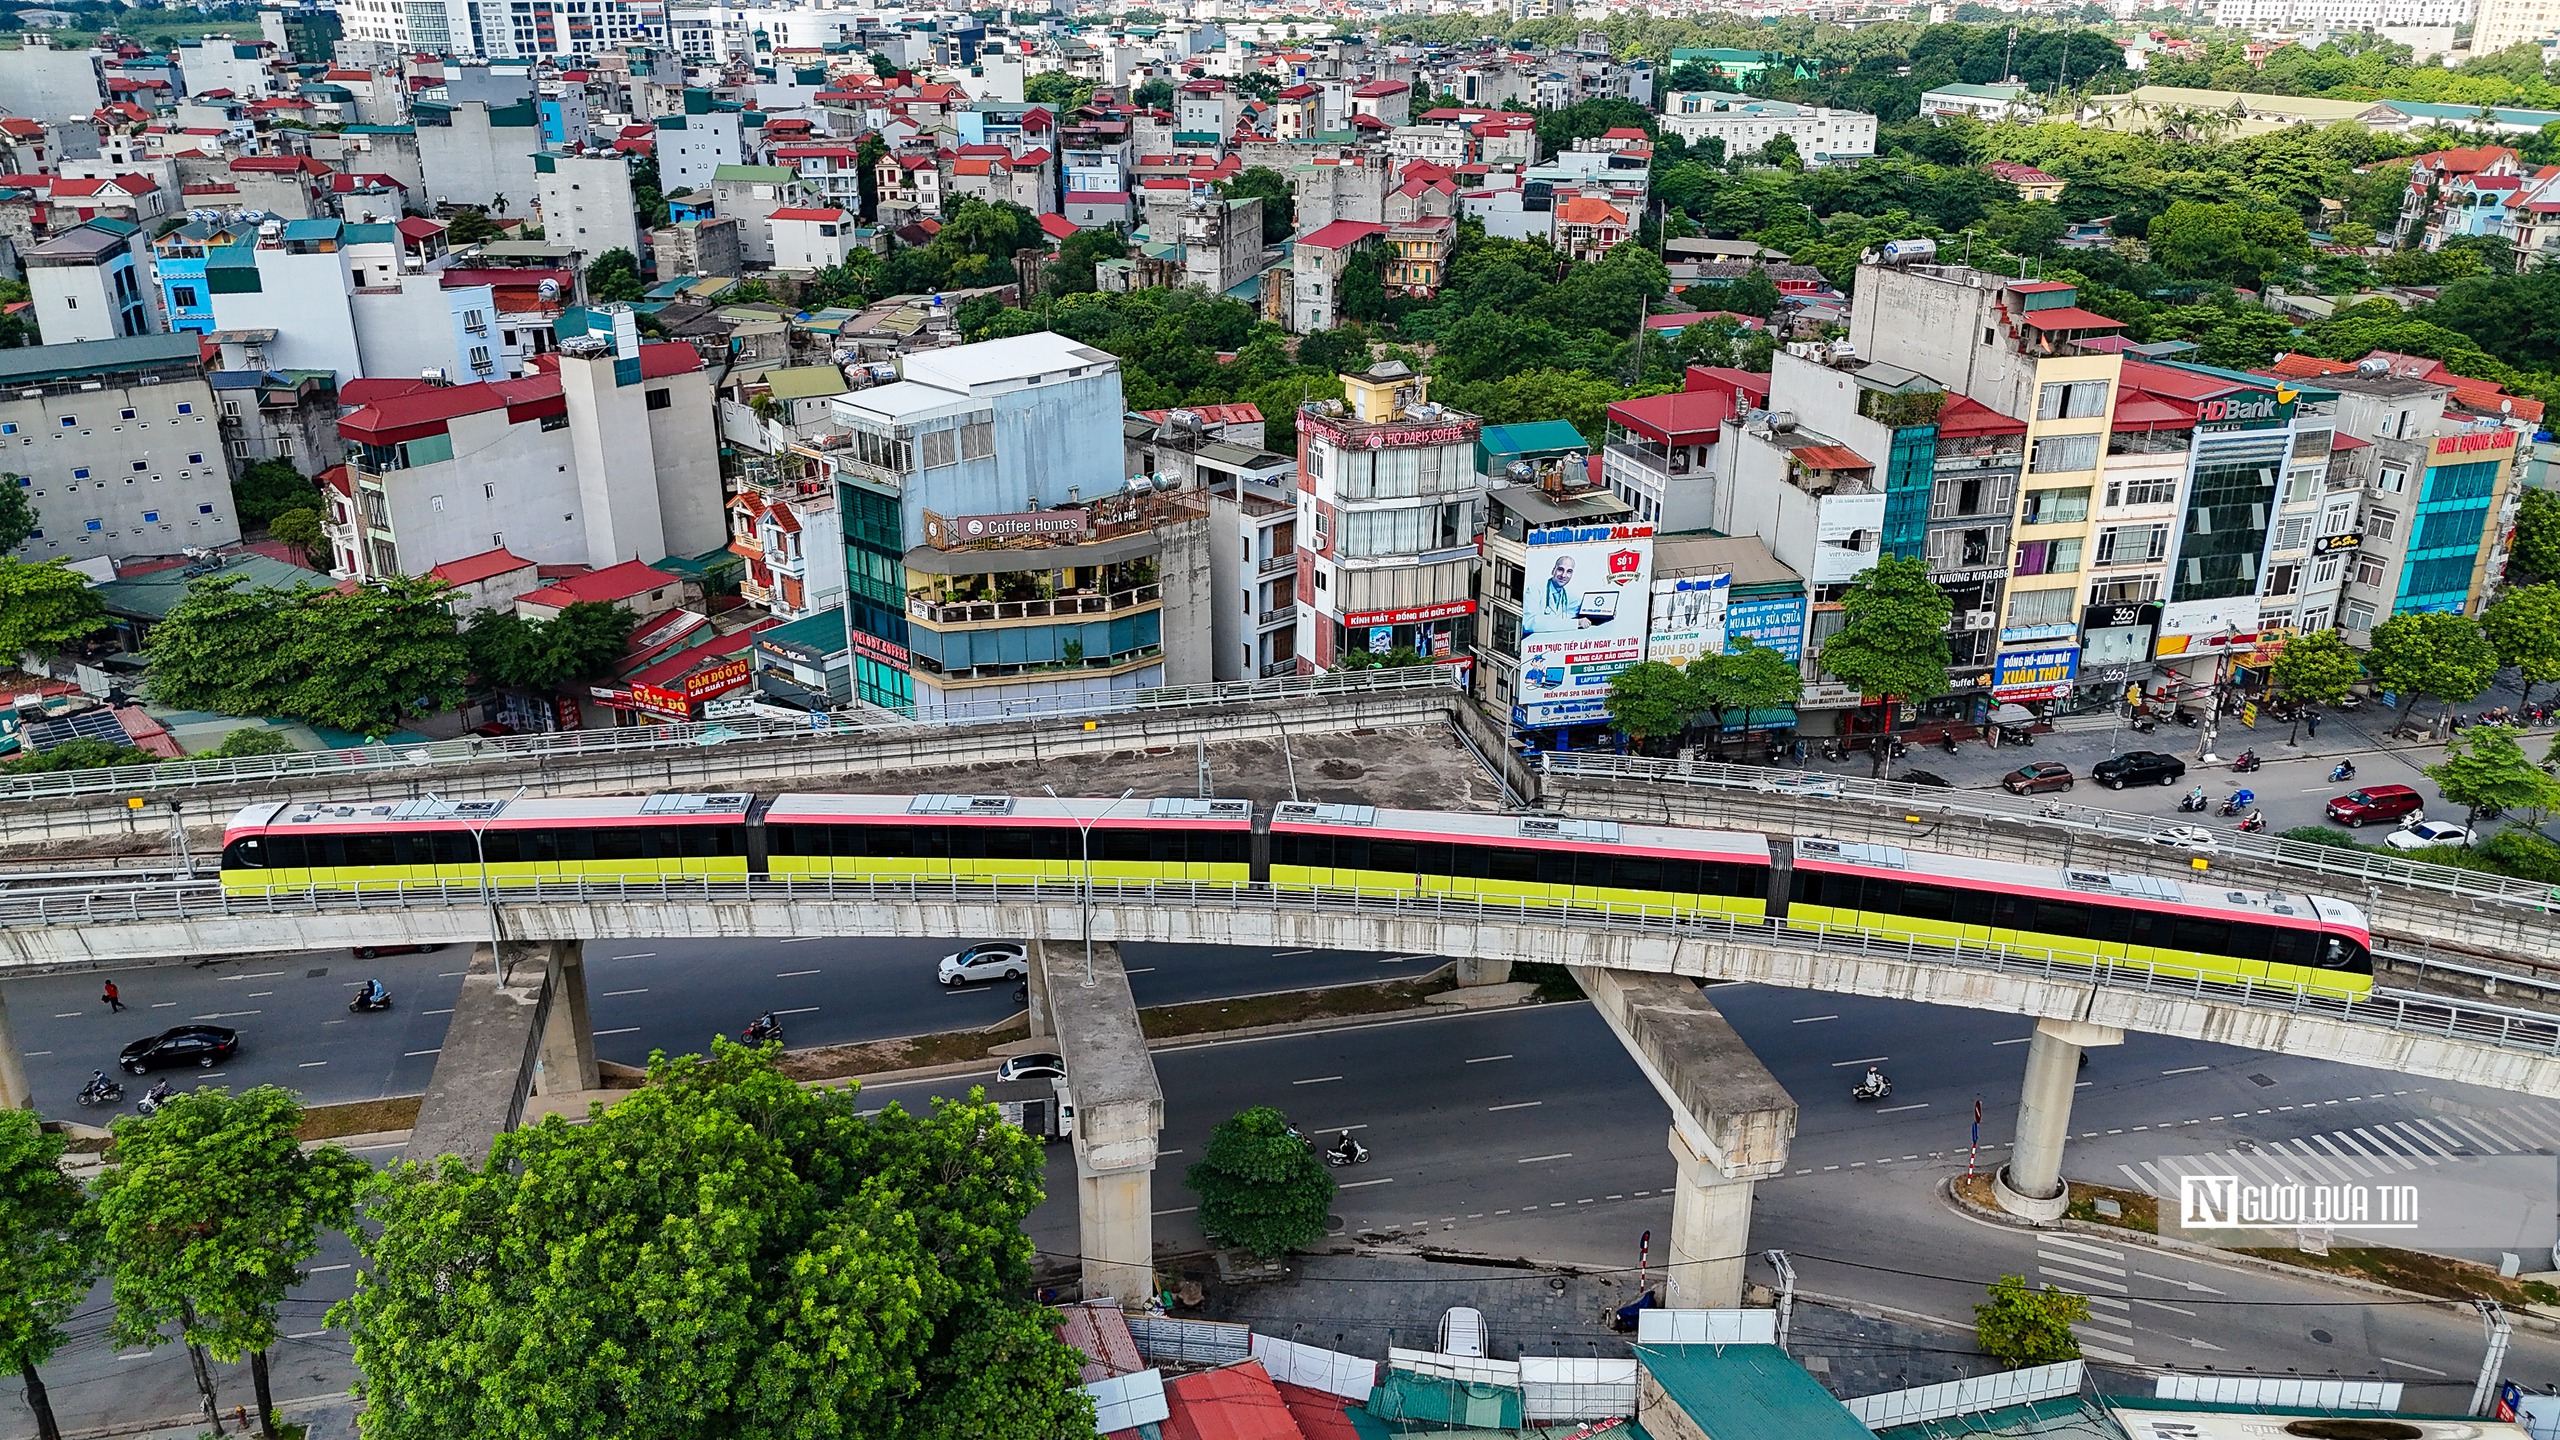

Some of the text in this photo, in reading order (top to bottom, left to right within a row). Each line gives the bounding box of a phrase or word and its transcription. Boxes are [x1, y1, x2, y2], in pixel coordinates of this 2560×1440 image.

[2197, 399, 2276, 421] HDBank
[1404, 430, 1429, 443] PARIS
[1431, 427, 1463, 440] COFFEE
[988, 520, 1031, 535] Coffee
[1035, 517, 1078, 531] Homes
[1575, 528, 1610, 541] LAPTOP
[1628, 557, 1632, 565] 1
[1350, 616, 1370, 625] KÍNH
[1372, 614, 1389, 623] MẮT
[1396, 611, 1417, 621] ĐỒNG
[1430, 608, 1445, 617] ĐỨC
[1447, 605, 1466, 614] PHÚC
[1729, 610, 1801, 629] MUA BÁN SỬA CHỮA
[852, 630, 880, 651] MELODY
[880, 641, 908, 662] COFFEE
[1527, 645, 1543, 654] XEM
[1563, 640, 1578, 651] TIẾP
[1580, 639, 1592, 650] LẤY
[1593, 640, 1611, 648] NGAY
[1617, 638, 1627, 647] UY
[1628, 637, 1639, 646] TÍN
[1650, 644, 1674, 657] BÚN
[1679, 642, 1695, 654] BÒ
[688, 672, 709, 689] CẦM
[727, 673, 747, 686] THẤP
[1950, 678, 1975, 688] Buffet
[2002, 664, 2070, 685] XUÂN THỦY
[633, 689, 665, 706] CẦM
[667, 695, 687, 712] ĐỒ
